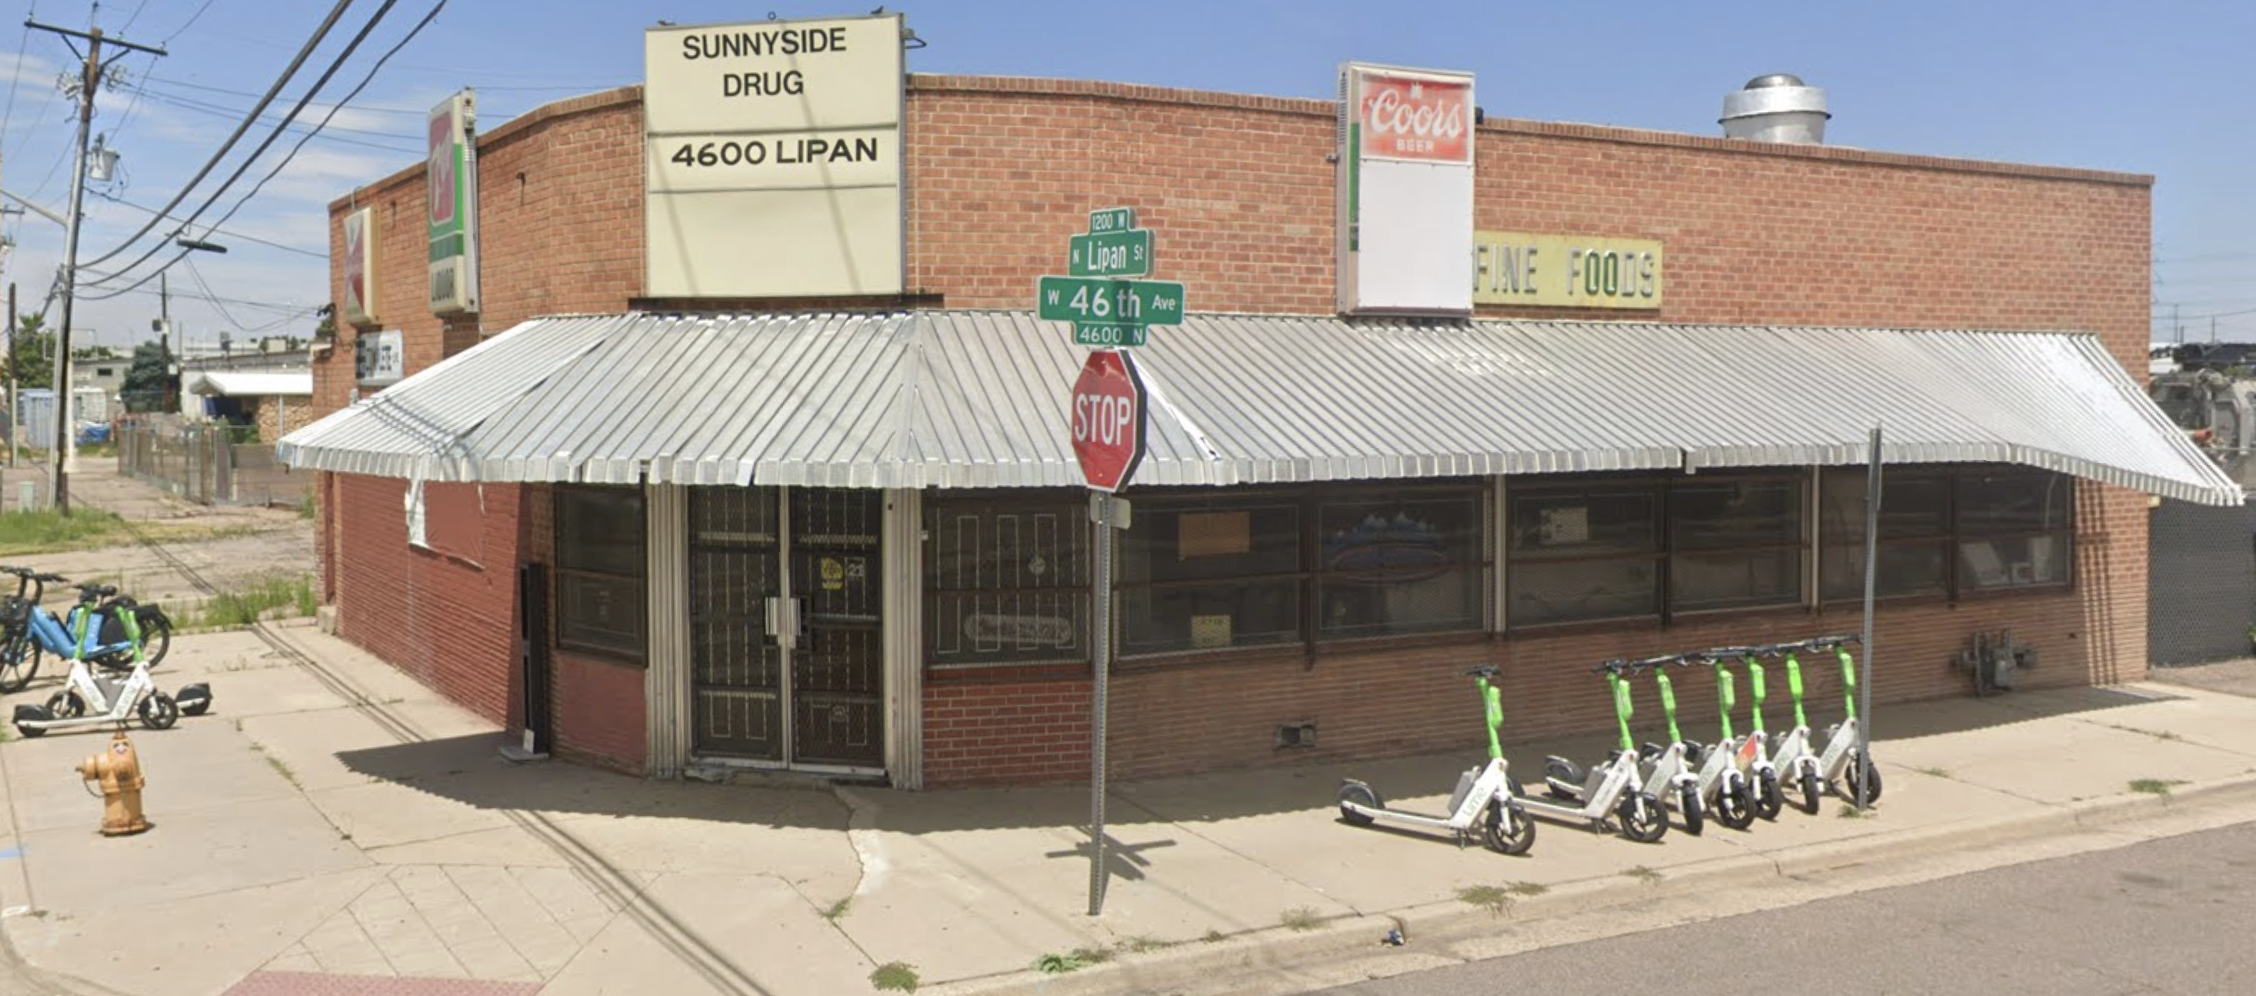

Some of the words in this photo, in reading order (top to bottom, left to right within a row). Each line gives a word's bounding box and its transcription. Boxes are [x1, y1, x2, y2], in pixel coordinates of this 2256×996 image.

[682, 27, 847, 60] SUNNYSIDE
[723, 70, 804, 97] DRUG
[1367, 88, 1464, 139] Coors
[671, 141, 767, 167] 4600
[776, 137, 878, 164] LIPAN
[1396, 138, 1435, 153] BEER
[1092, 213, 1113, 230] 1200
[1117, 212, 1126, 228] W
[1072, 249, 1080, 264] N
[1087, 241, 1127, 273] Lipan
[1133, 244, 1144, 261] St
[1473, 243, 1538, 294] FINE
[1565, 248, 1654, 298] FOODS
[1047, 289, 1060, 306] W
[1069, 285, 1141, 318] 46th
[1151, 294, 1176, 311] Ave
[1079, 326, 1123, 342] 4600
[1133, 328, 1143, 343] N
[1074, 392, 1132, 446] STOP
